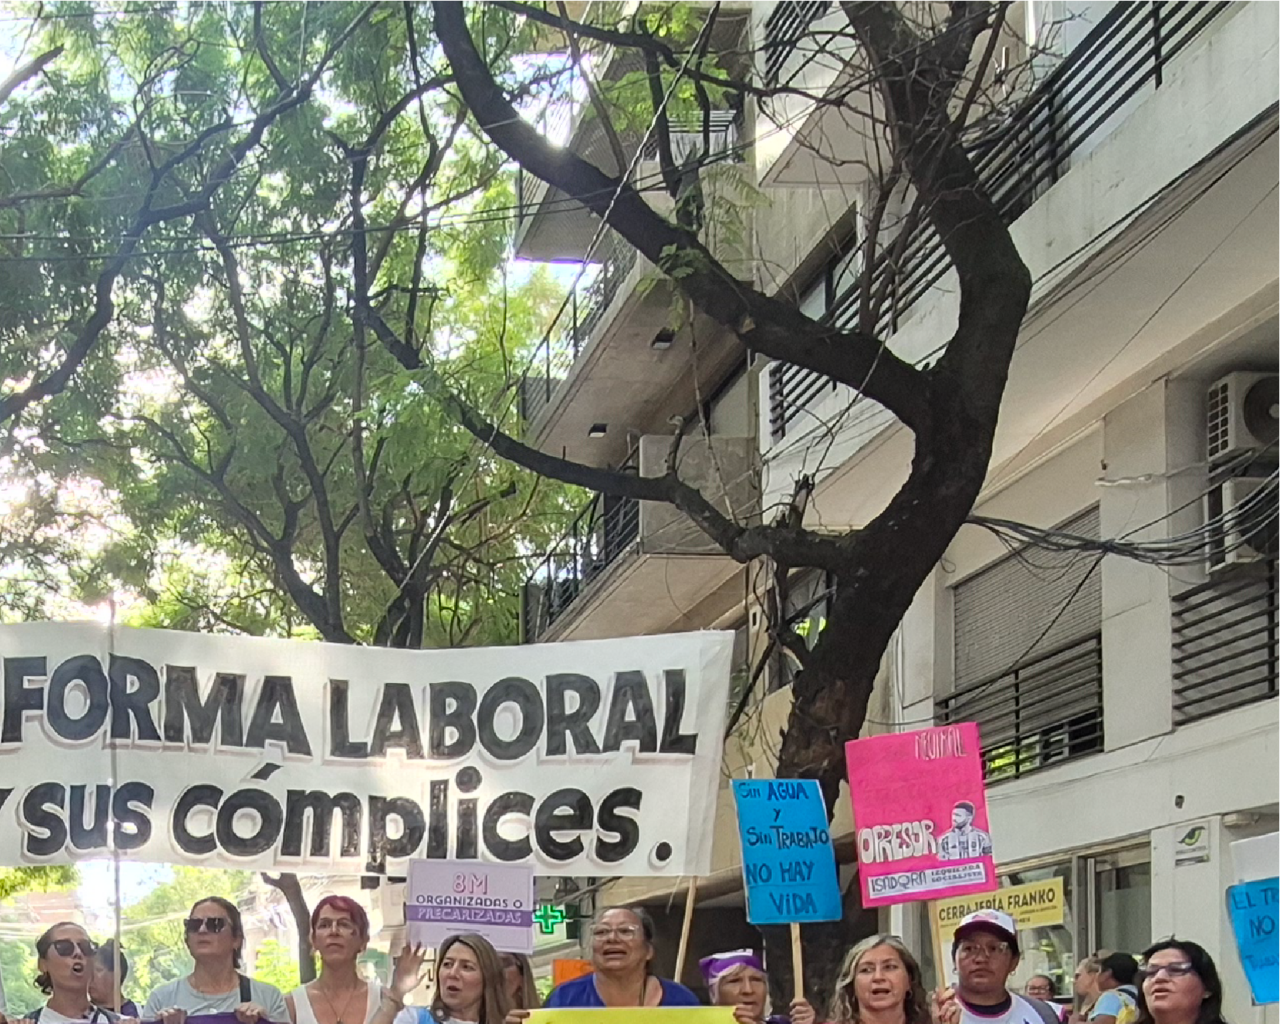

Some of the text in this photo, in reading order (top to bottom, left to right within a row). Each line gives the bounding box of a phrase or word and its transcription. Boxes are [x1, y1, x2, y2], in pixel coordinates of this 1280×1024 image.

[329, 668, 700, 760] LABORAL
[767, 782, 809, 801] AGUA
[24, 780, 155, 857] sus
[173, 763, 674, 875] cómplices.
[769, 825, 829, 850] TRABAJO
[858, 819, 937, 864] OPRESOR
[453, 872, 488, 895] 8M
[746, 861, 815, 884] NO HAY
[416, 895, 523, 909] ORGANIZADAS O
[1007, 887, 1056, 910] FRANKO
[1231, 890, 1257, 910] EL
[418, 907, 522, 924] PRECARIZADAS
[1249, 914, 1276, 939] NO
